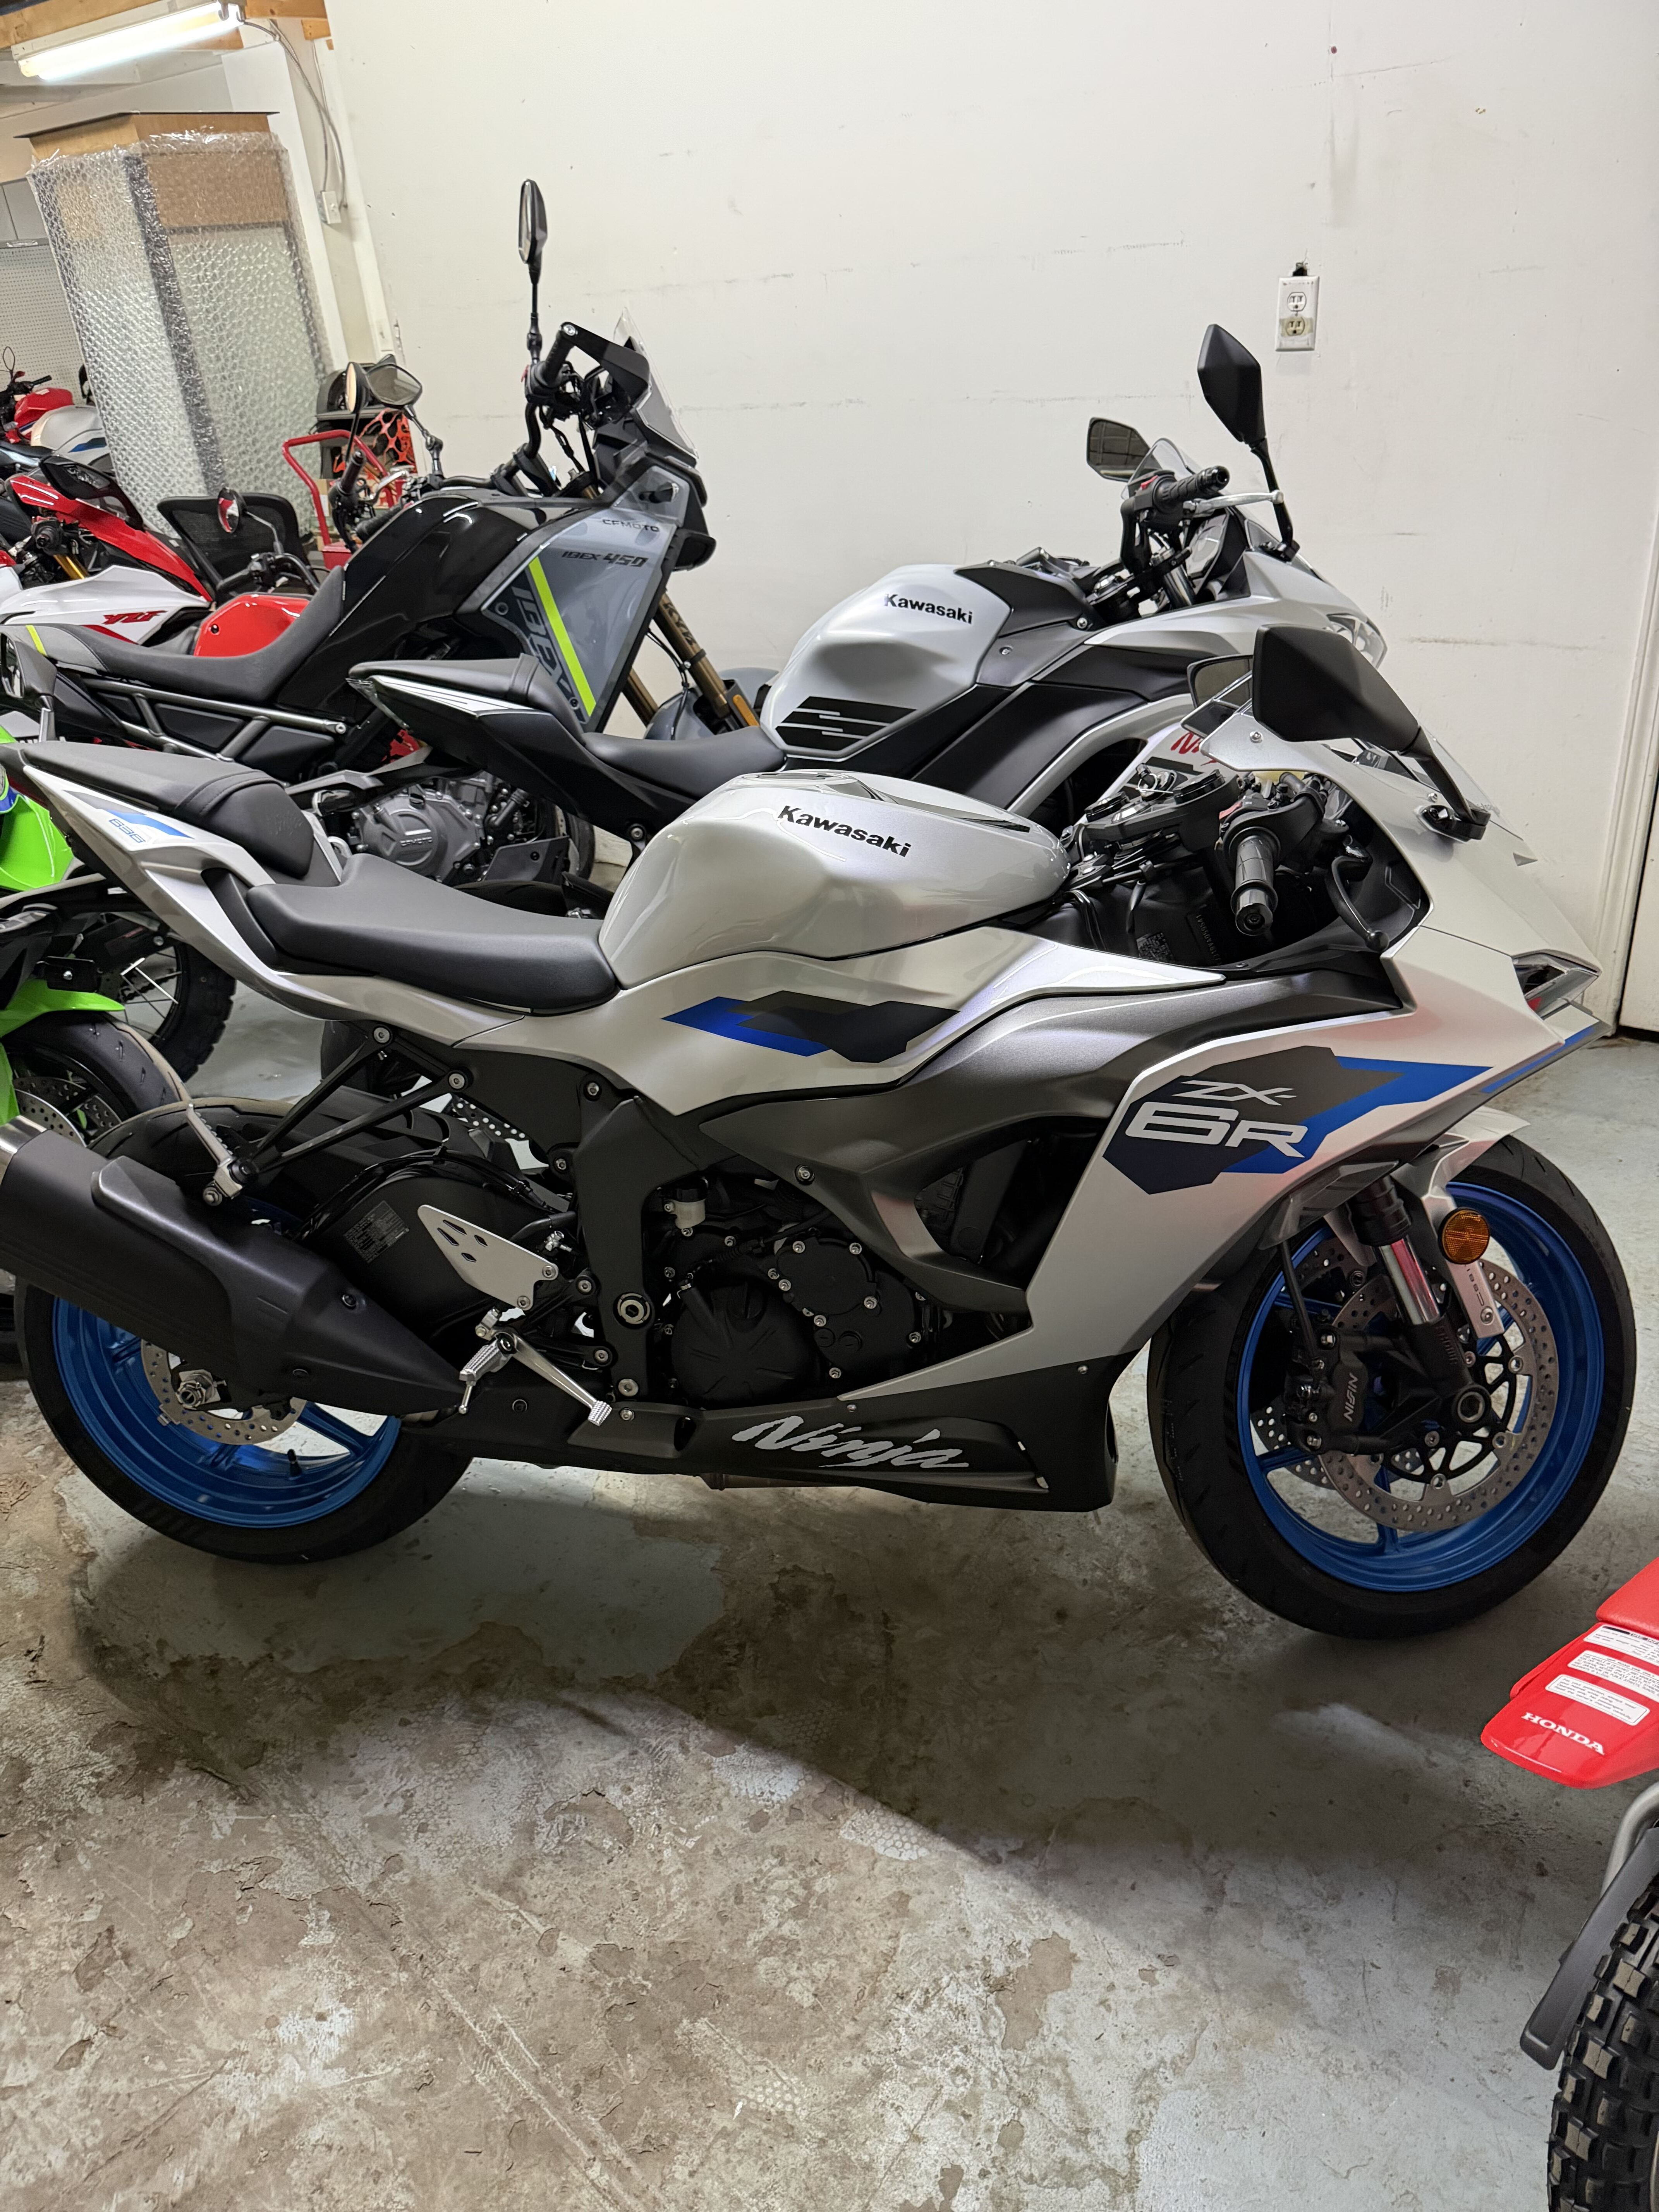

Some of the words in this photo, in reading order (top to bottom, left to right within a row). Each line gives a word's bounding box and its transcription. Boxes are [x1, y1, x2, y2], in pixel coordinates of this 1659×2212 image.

[602, 519, 660, 532] CFMOTO
[562, 551, 602, 560] IBEX
[603, 553, 649, 567] 450
[884, 594, 973, 625] Kawasaki
[108, 818, 146, 843] 636
[776, 805, 912, 858] Kawasaki
[1125, 1102, 1308, 1158] 6R
[1343, 1372, 1358, 1422] NISSIN
[732, 1415, 969, 1468] Ninja
[1521, 1712, 1605, 1755] HONDA
